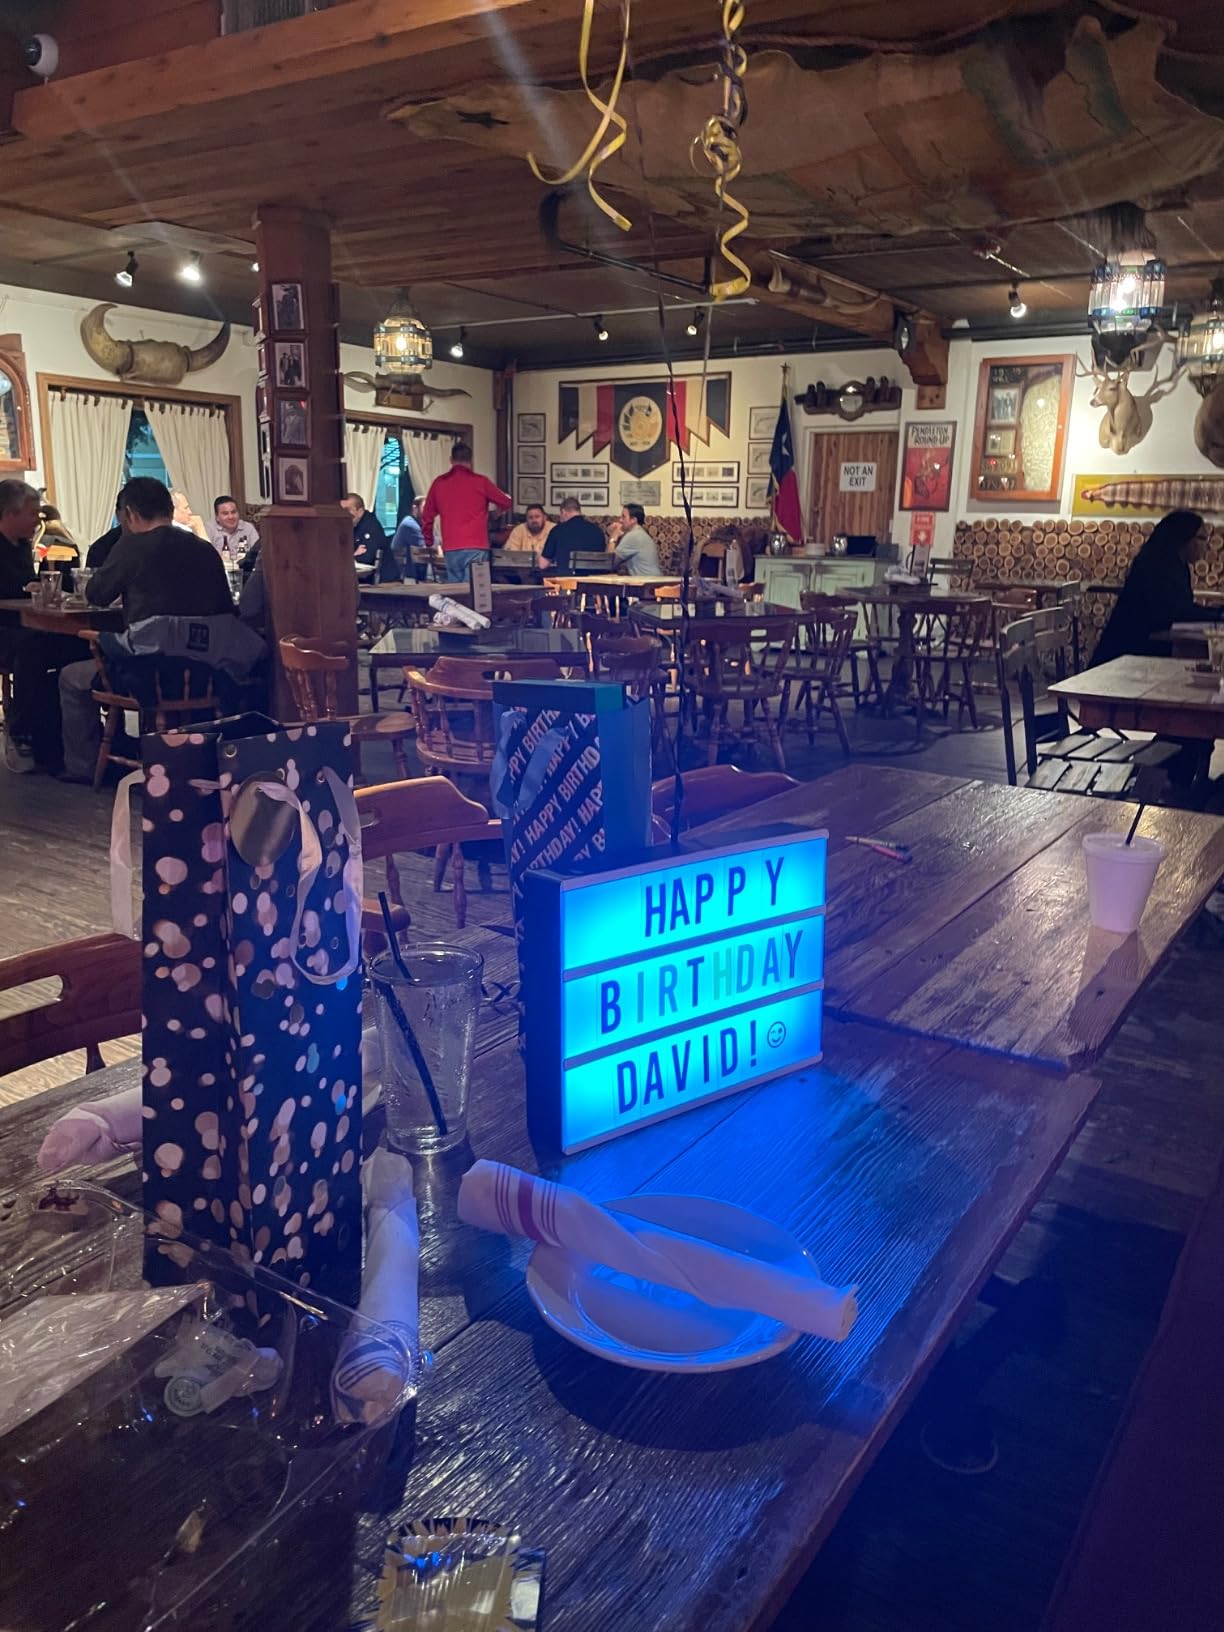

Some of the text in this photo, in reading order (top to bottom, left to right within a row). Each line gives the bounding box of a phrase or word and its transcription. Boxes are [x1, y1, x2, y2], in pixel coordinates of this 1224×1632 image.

[844, 466, 874, 475] NOT AN
[849, 477, 867, 486] EXIT
[524, 793, 562, 846] HAPPY
[557, 736, 601, 803] BIRTHD
[644, 856, 785, 937] HAPPY
[600, 929, 804, 1034] BIRTHDAY
[616, 1020, 757, 1114] DAVID!
